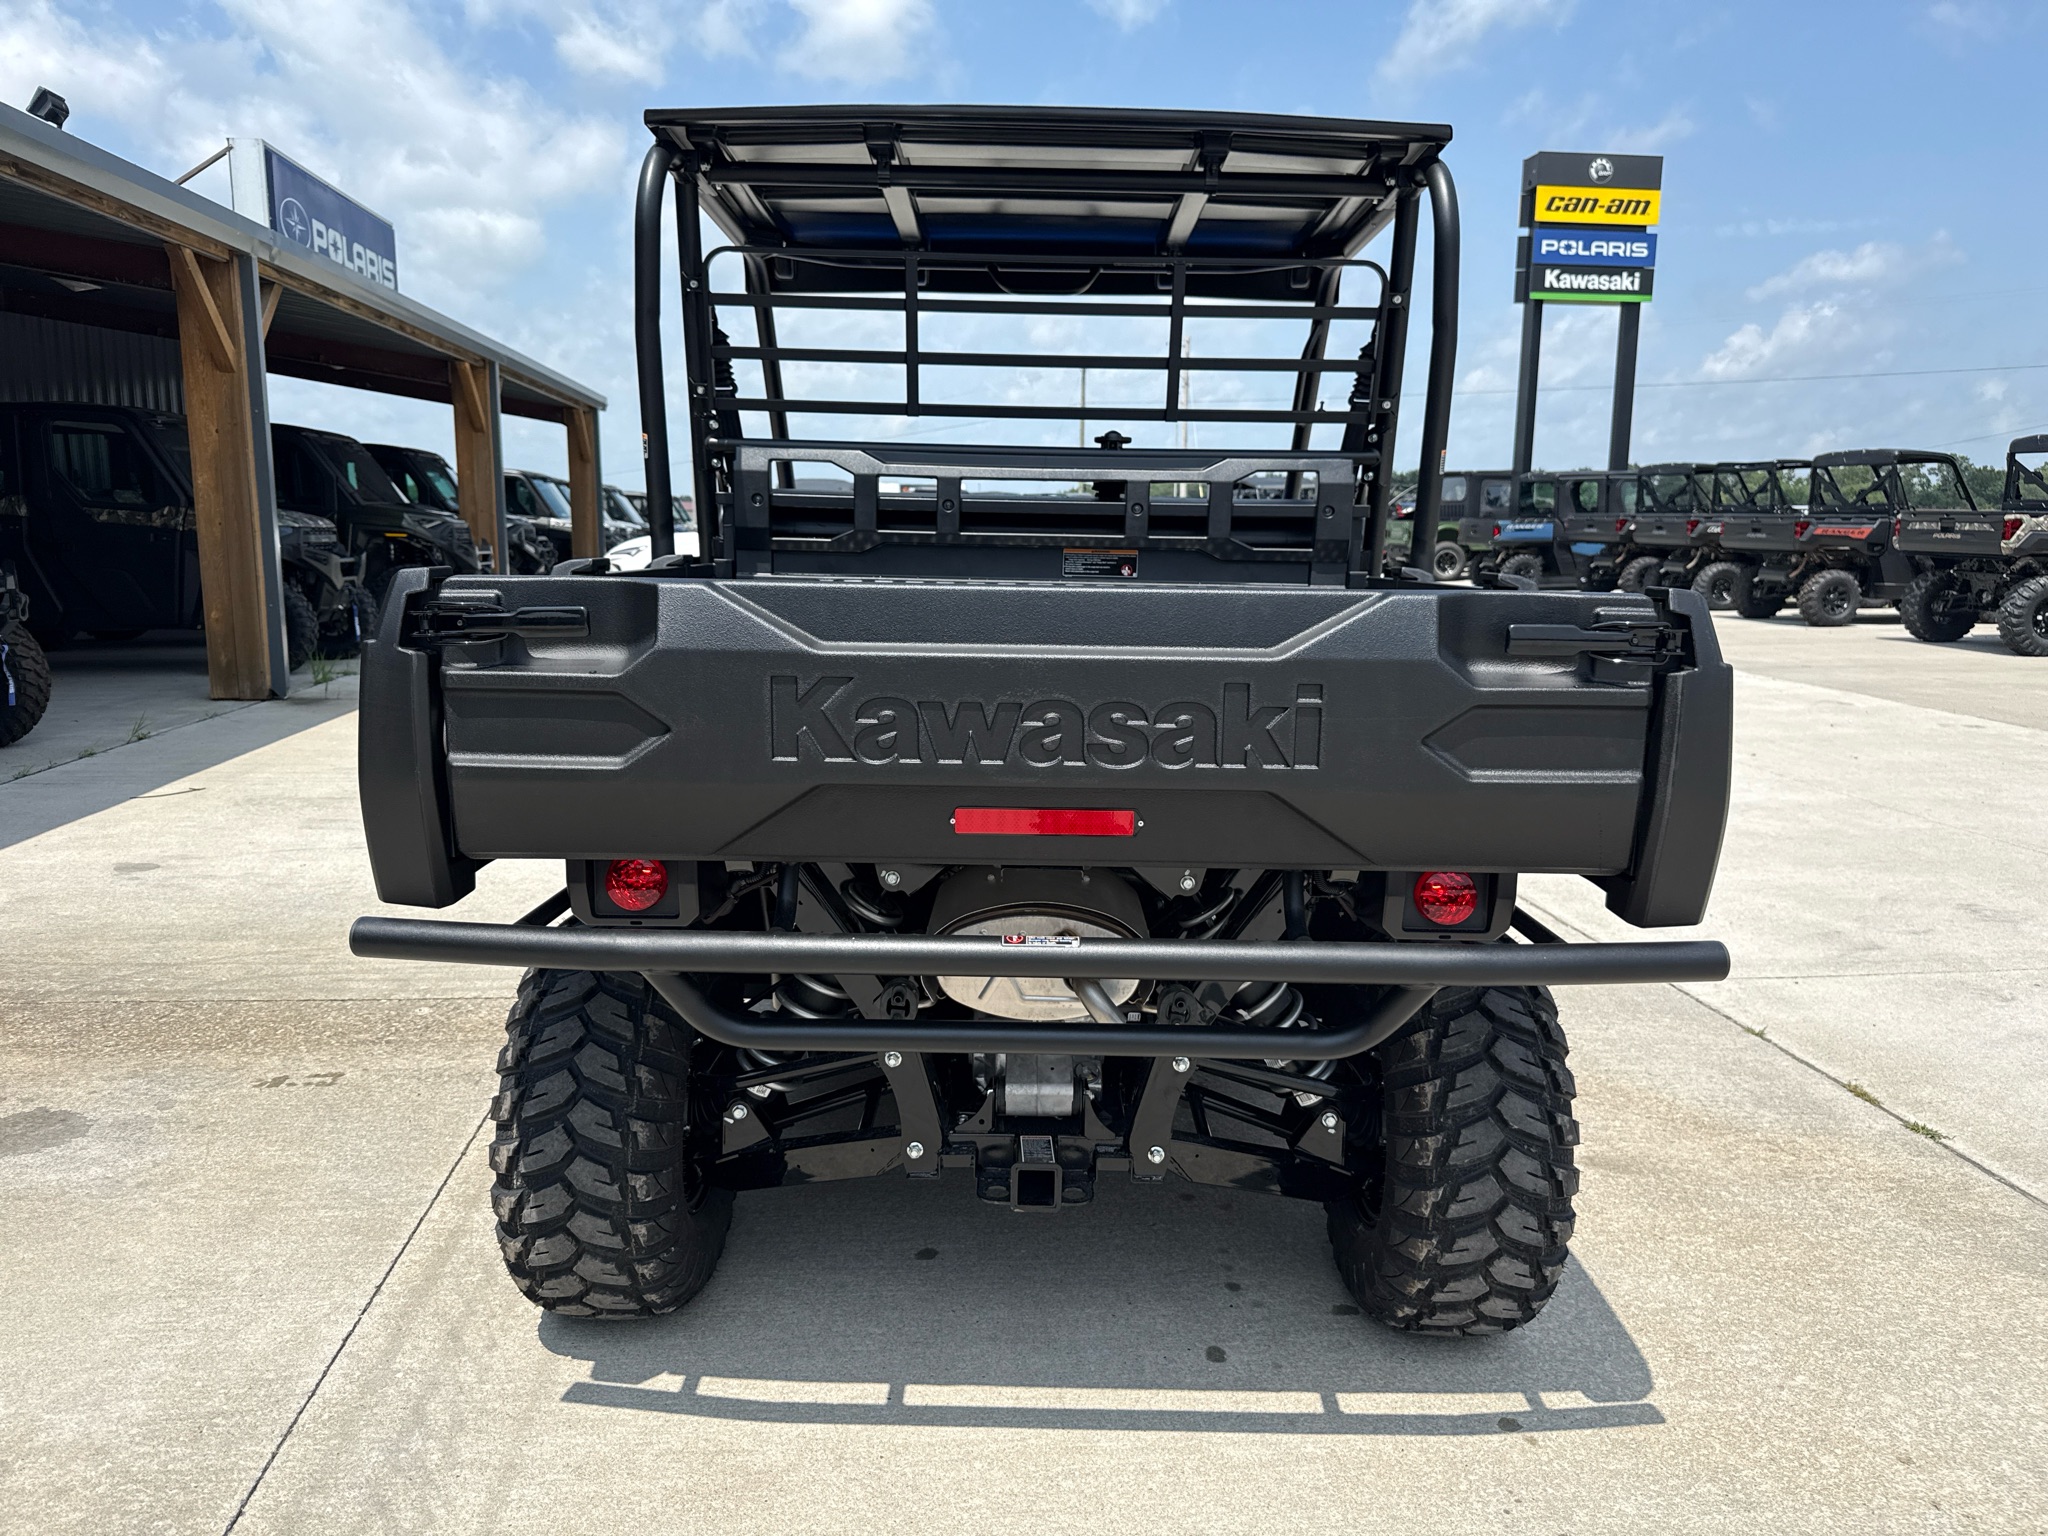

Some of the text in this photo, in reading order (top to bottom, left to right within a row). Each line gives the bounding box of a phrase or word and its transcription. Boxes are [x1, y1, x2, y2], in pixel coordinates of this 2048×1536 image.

[1545, 196, 1651, 215] can-am
[311, 218, 396, 290] POLARIS
[1541, 239, 1649, 258] POLARIS
[1544, 269, 1641, 291] Kawasaki
[769, 675, 1324, 770] Kawasaki
